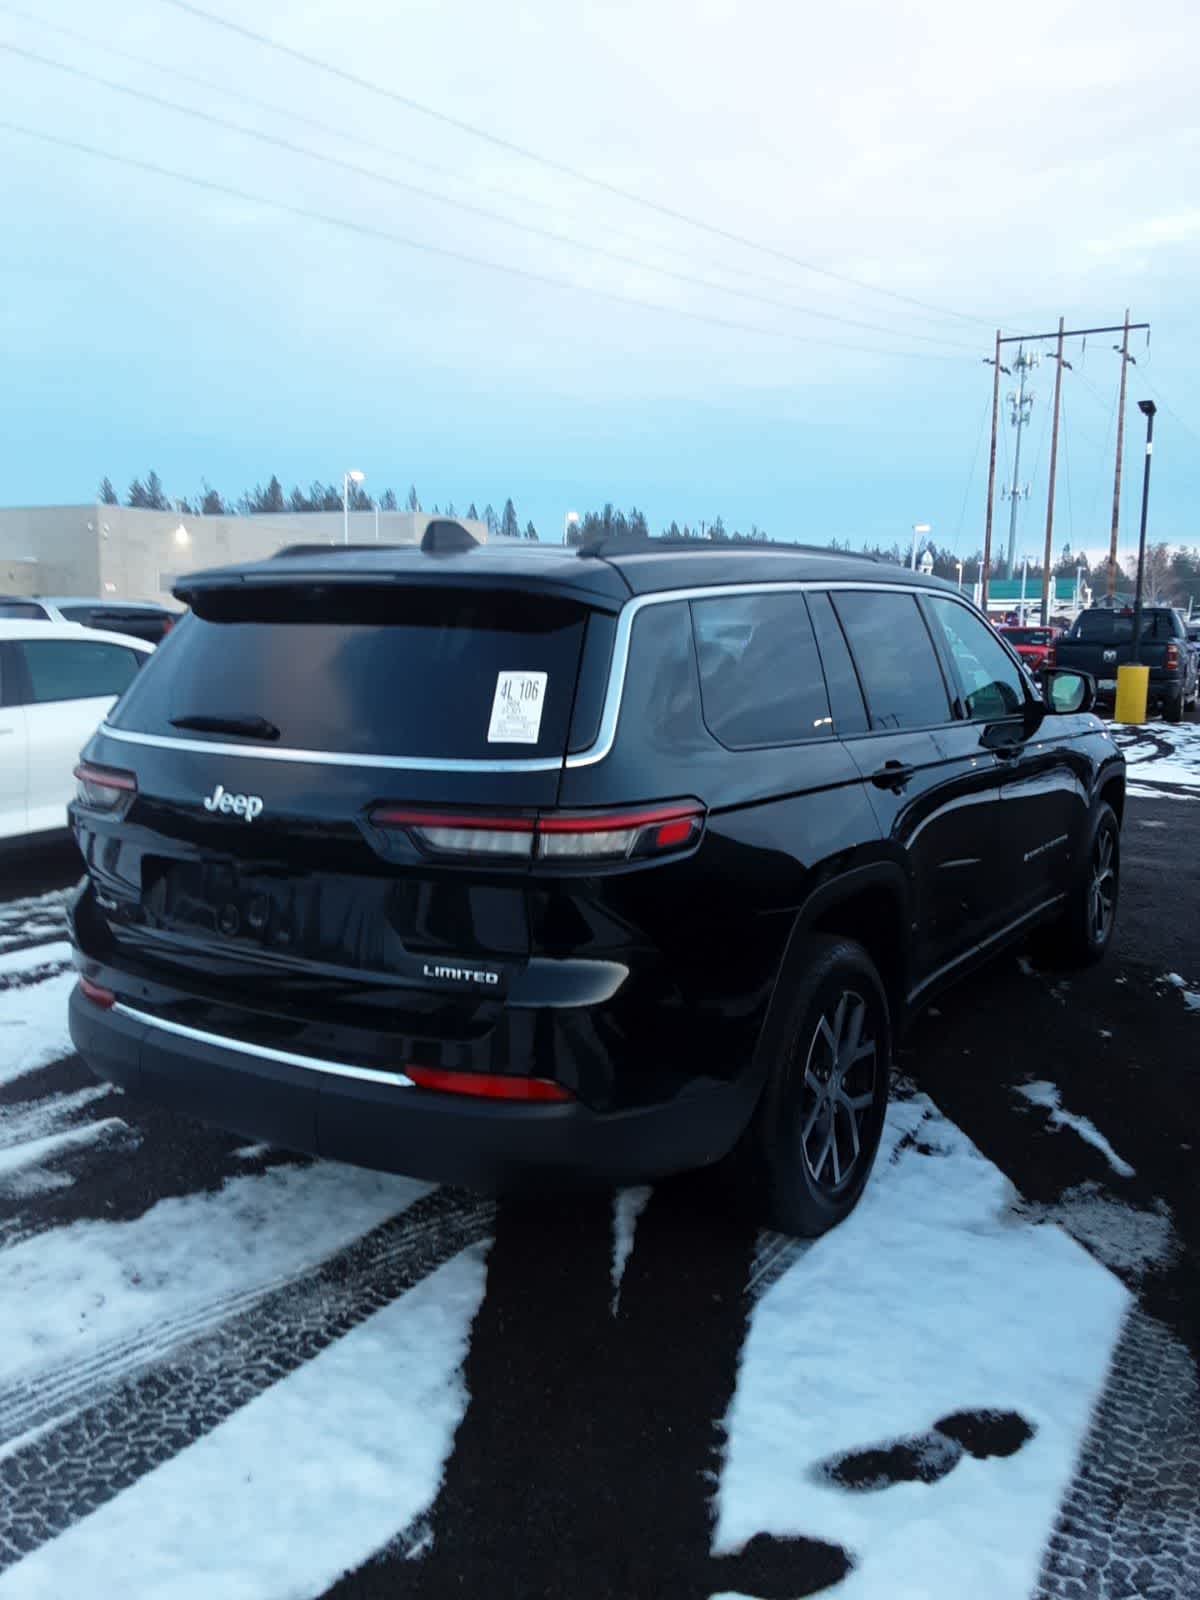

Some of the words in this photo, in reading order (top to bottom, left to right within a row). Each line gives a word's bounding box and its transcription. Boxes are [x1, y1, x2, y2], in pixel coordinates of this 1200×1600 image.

[520, 679, 539, 701] 106
[203, 784, 263, 823] Jeep
[423, 964, 499, 984] LIMITED
